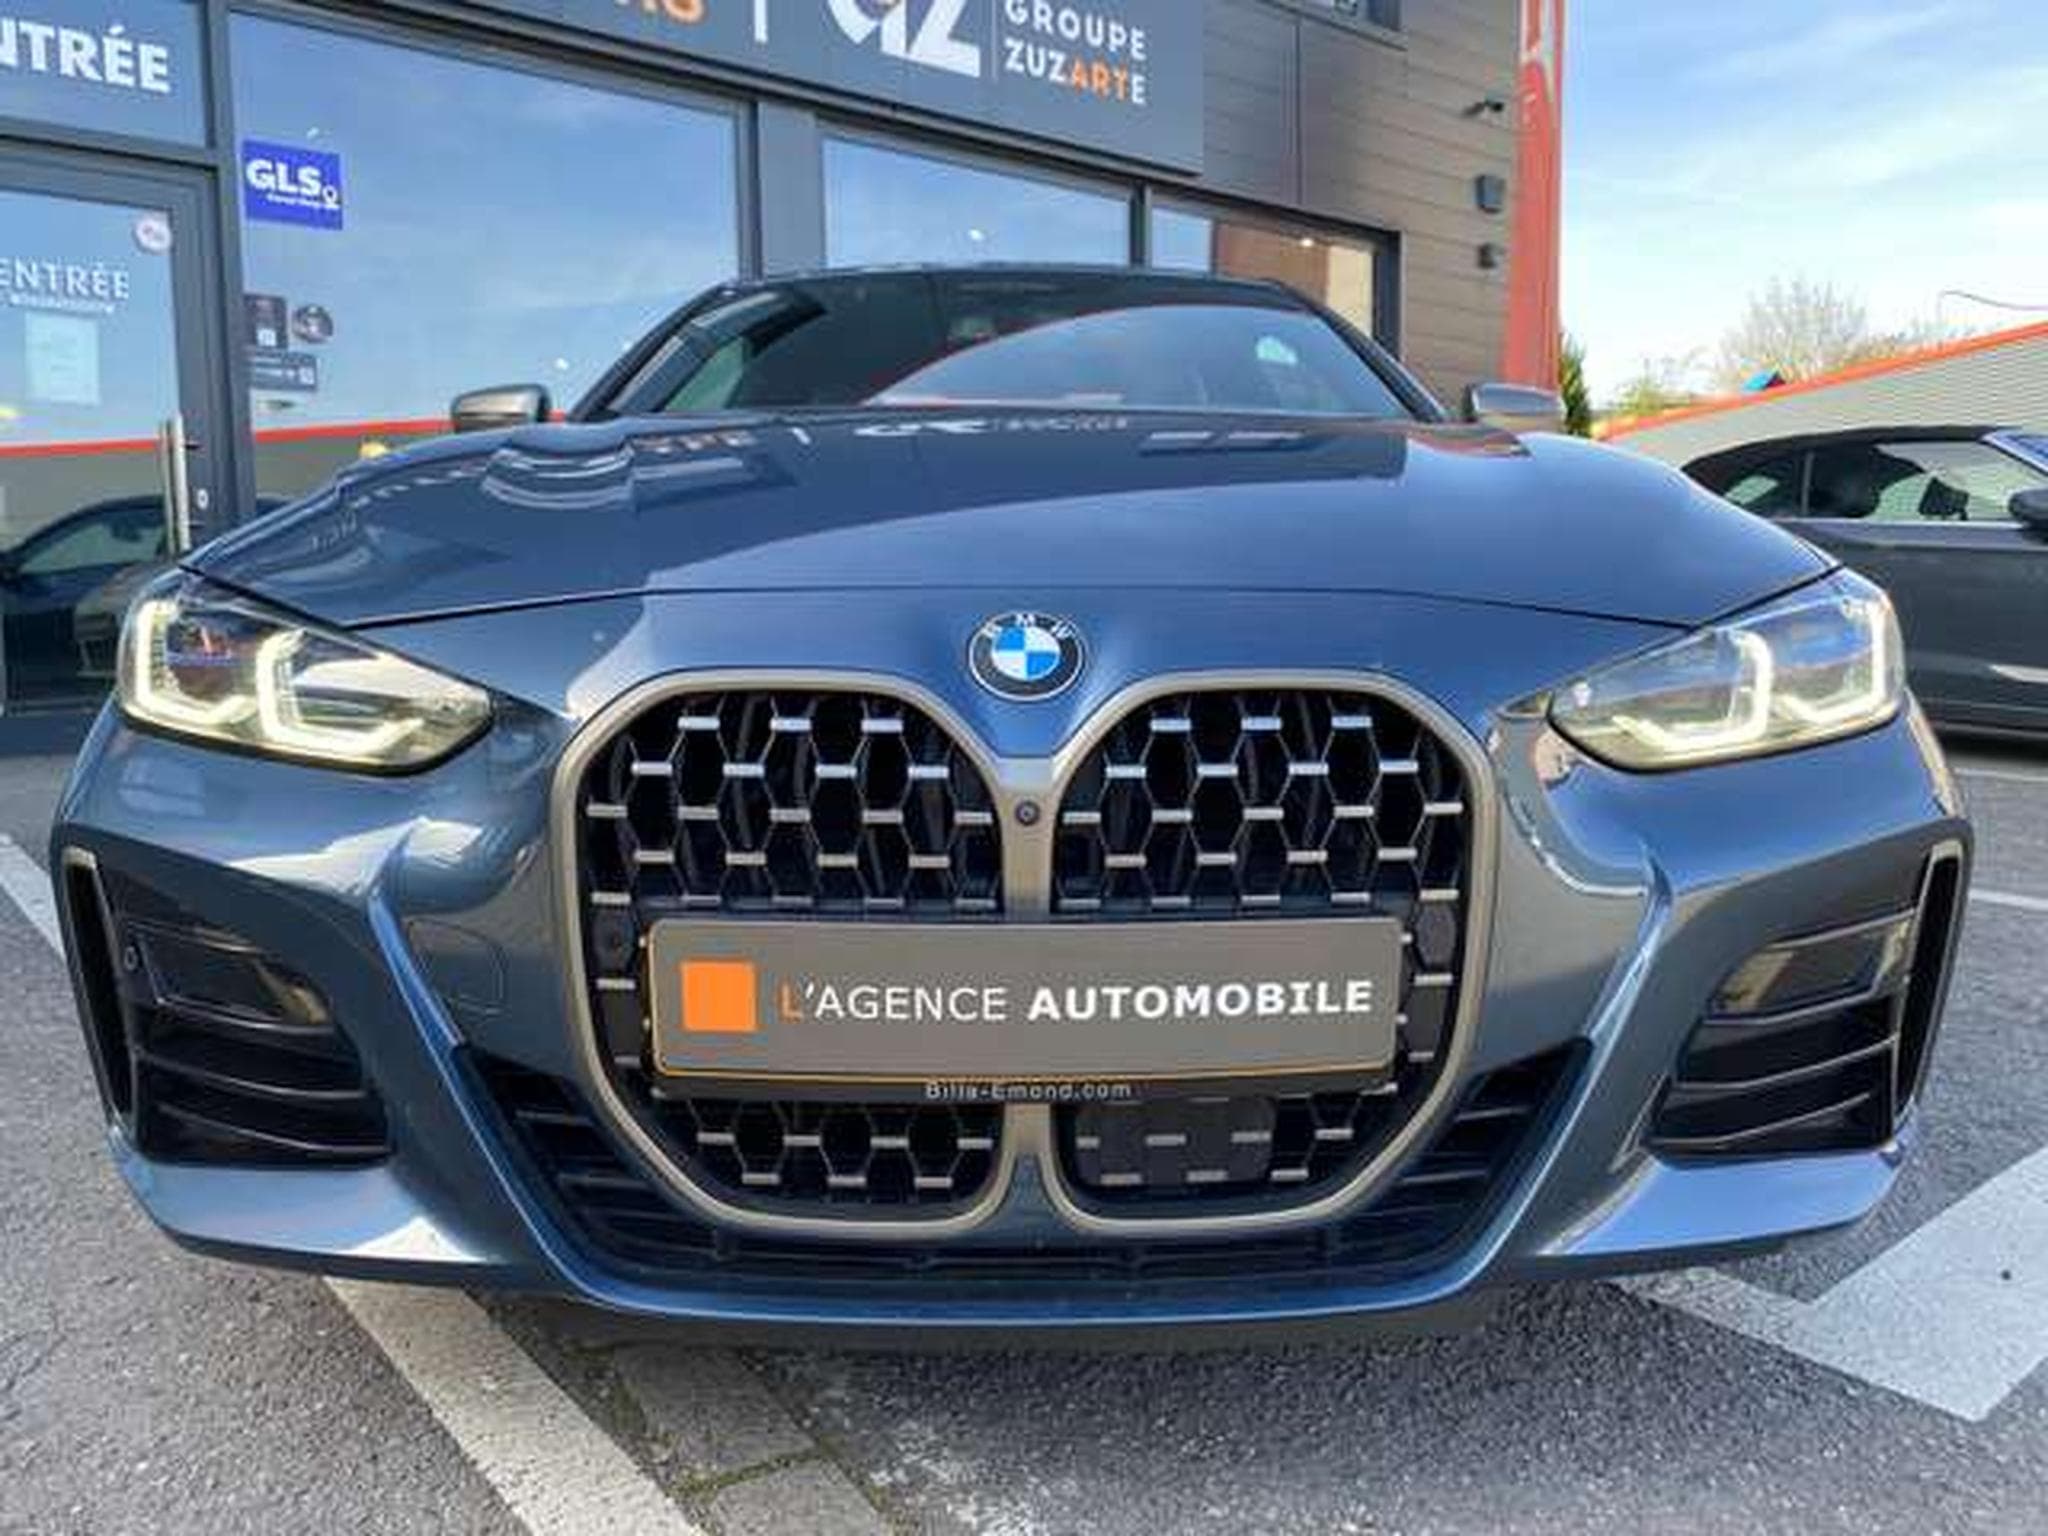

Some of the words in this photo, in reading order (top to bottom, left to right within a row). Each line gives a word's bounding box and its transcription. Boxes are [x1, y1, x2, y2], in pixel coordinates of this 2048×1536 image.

[1004, 0, 1145, 61] GROUPE
[1004, 38, 1145, 105] ZUZARTE
[247, 159, 321, 197] GLS
[1027, 980, 1373, 1021] AUTOMOBILE
